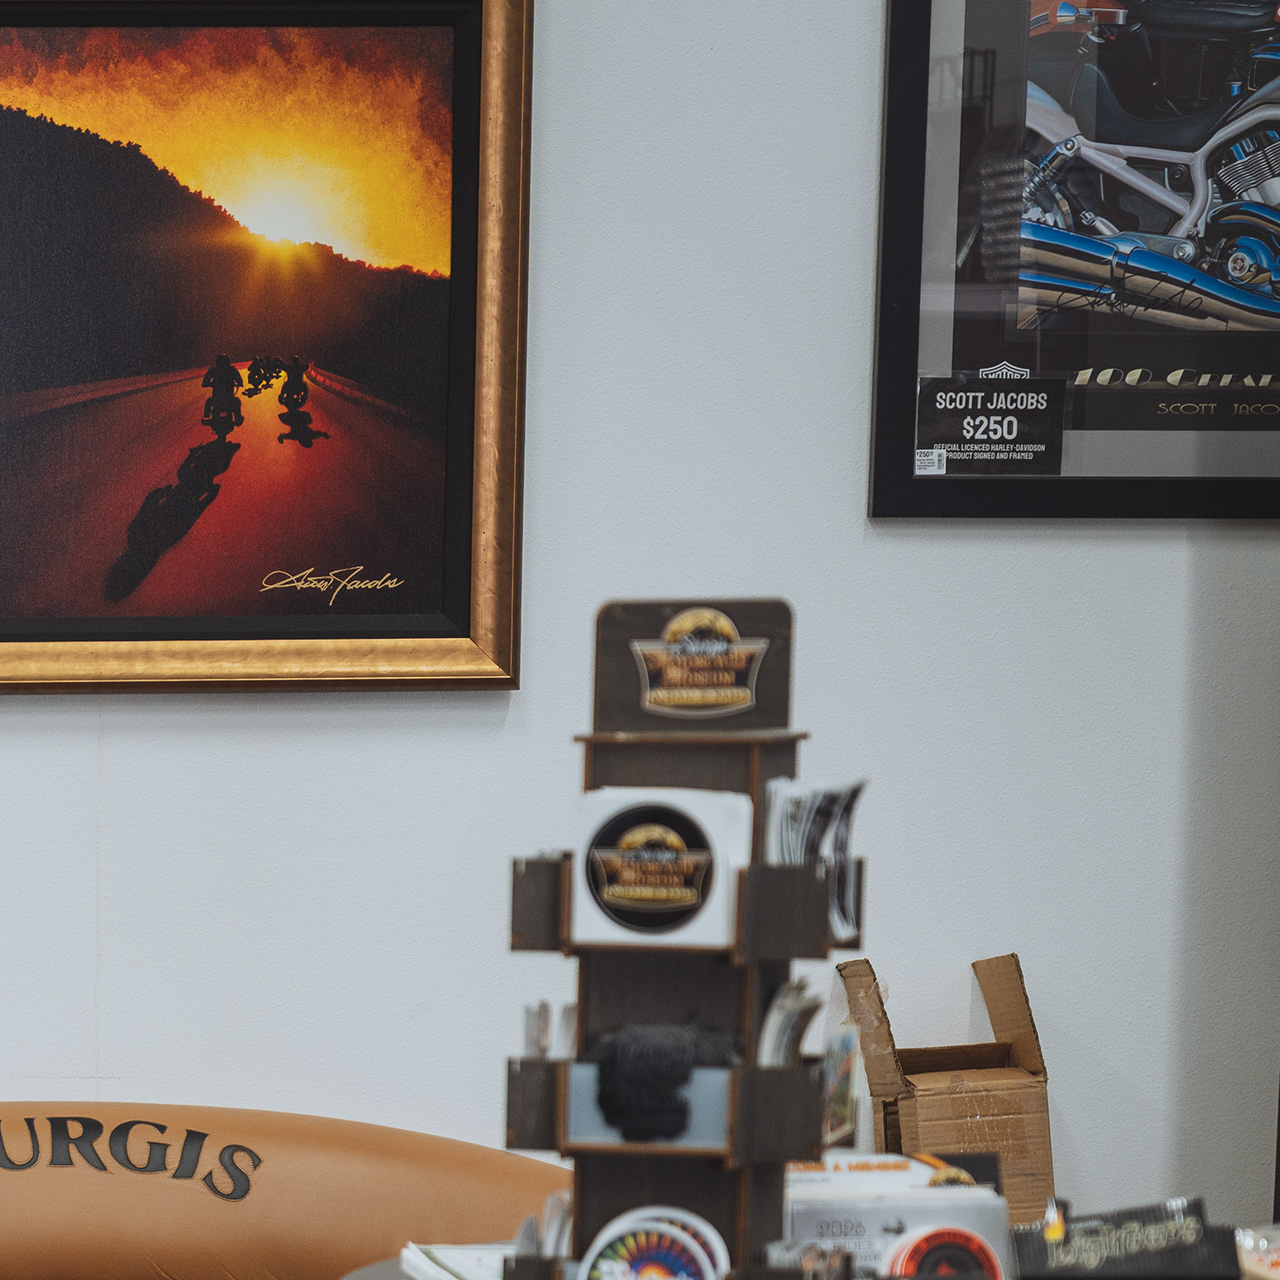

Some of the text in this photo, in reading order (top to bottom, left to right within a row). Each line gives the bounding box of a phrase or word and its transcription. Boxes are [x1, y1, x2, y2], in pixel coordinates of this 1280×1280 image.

[1074, 367, 1153, 386] 100
[936, 392, 1047, 409] SCOTT JACOBS
[1157, 403, 1217, 415] SCOTT
[962, 415, 1018, 440] $250
[933, 443, 960, 451] OFFICIAL
[991, 444, 1045, 452] HARLEY-DAVIDSON
[974, 452, 995, 460] SIGNED
[996, 452, 1008, 460] AND
[1008, 452, 1034, 460] FRAMED
